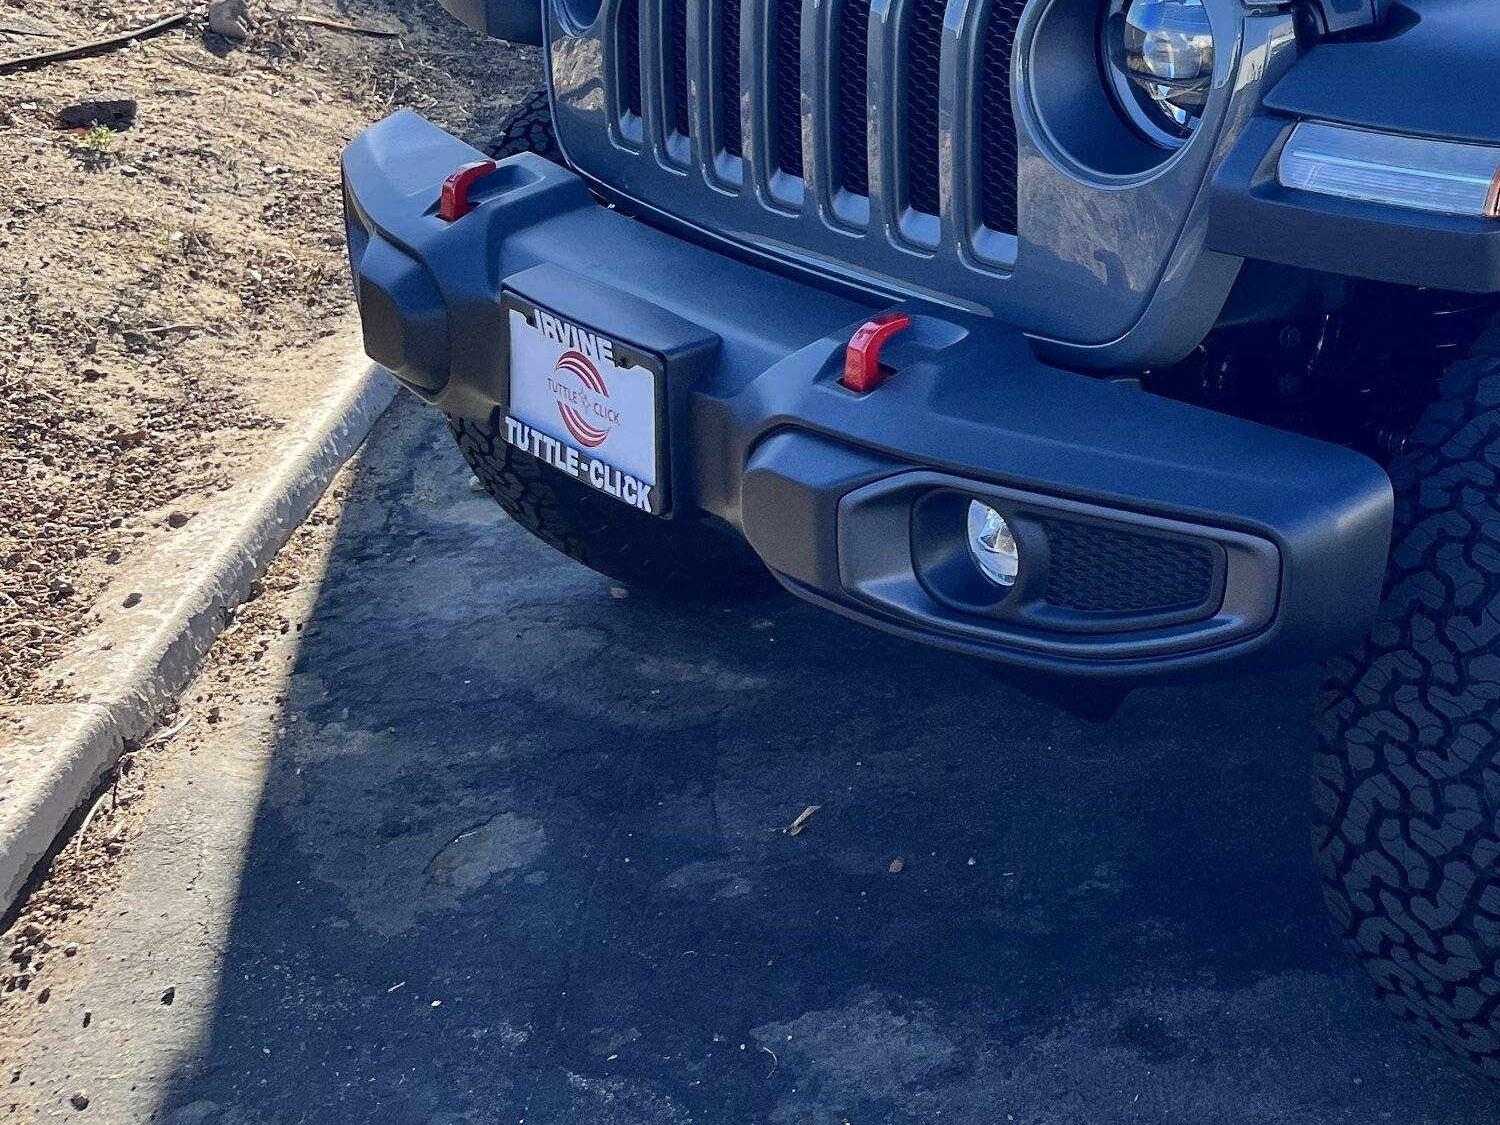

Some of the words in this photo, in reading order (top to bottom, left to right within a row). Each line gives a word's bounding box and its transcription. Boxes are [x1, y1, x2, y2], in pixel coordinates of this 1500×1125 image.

[533, 308, 614, 364] IRVINE
[547, 377, 577, 404] TUTTLE
[594, 402, 621, 426] CLICK
[505, 416, 652, 513] TUTTLE-CLICK
